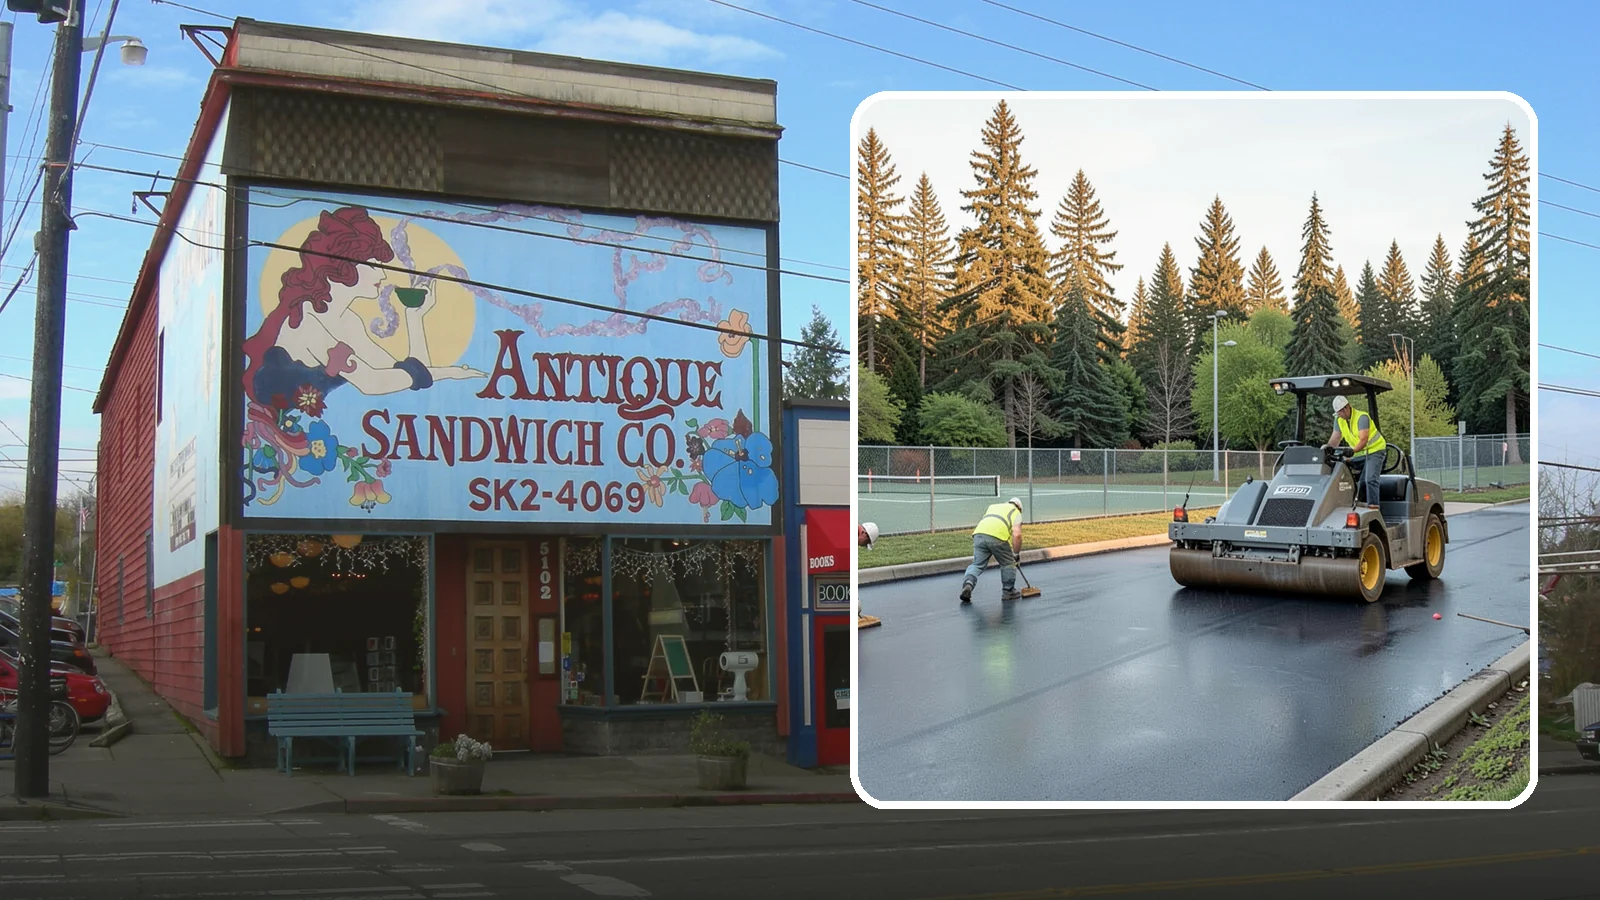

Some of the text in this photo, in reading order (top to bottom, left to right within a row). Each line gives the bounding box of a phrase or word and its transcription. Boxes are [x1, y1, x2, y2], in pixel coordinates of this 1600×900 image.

[475, 329, 723, 421] ANTIQUE
[361, 408, 684, 468] SANDWICH CO.
[468, 477, 646, 513] SK2-4069
[540, 541, 552, 600] 5102
[809, 555, 835, 569] BOOKS
